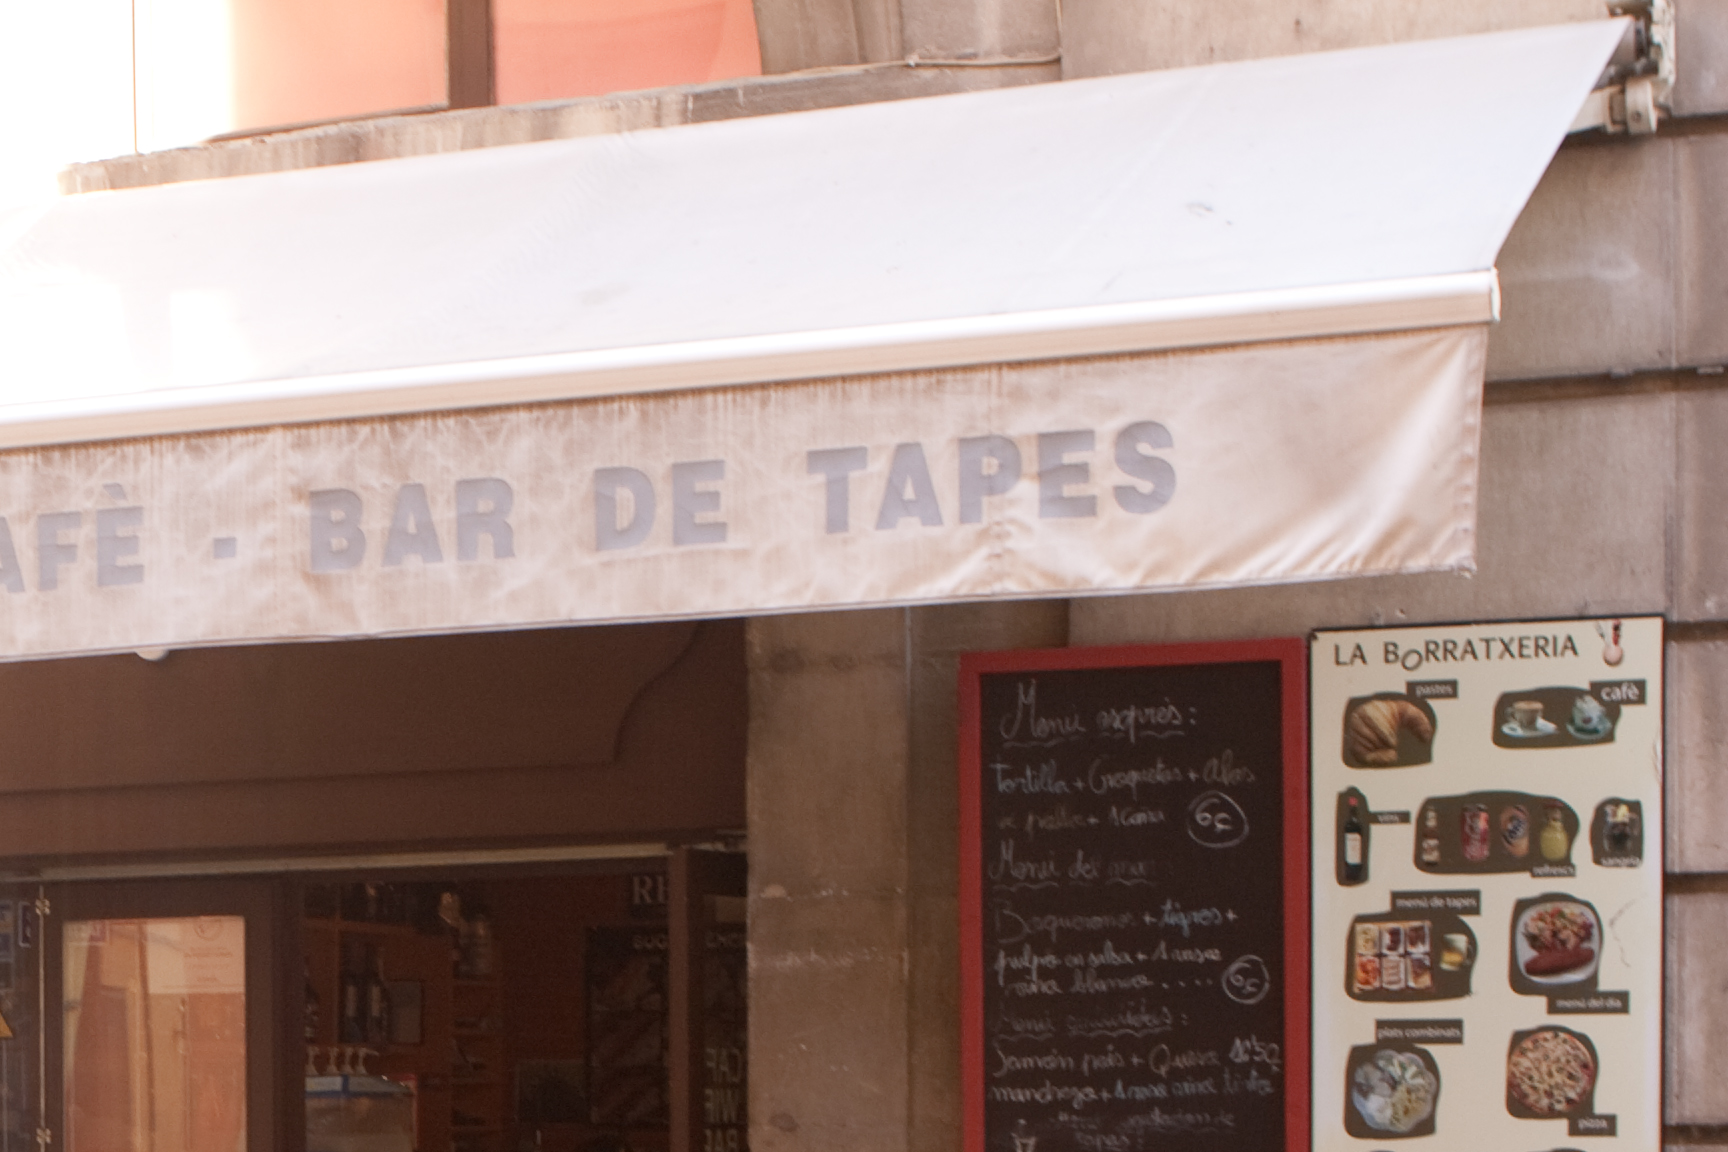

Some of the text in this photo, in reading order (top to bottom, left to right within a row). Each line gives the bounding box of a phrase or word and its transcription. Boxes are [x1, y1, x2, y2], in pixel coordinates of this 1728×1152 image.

[309, 477, 516, 574] BAR
[594, 460, 727, 551] DE
[807, 420, 1177, 534] TAPES
[1334, 643, 1368, 667] LA
